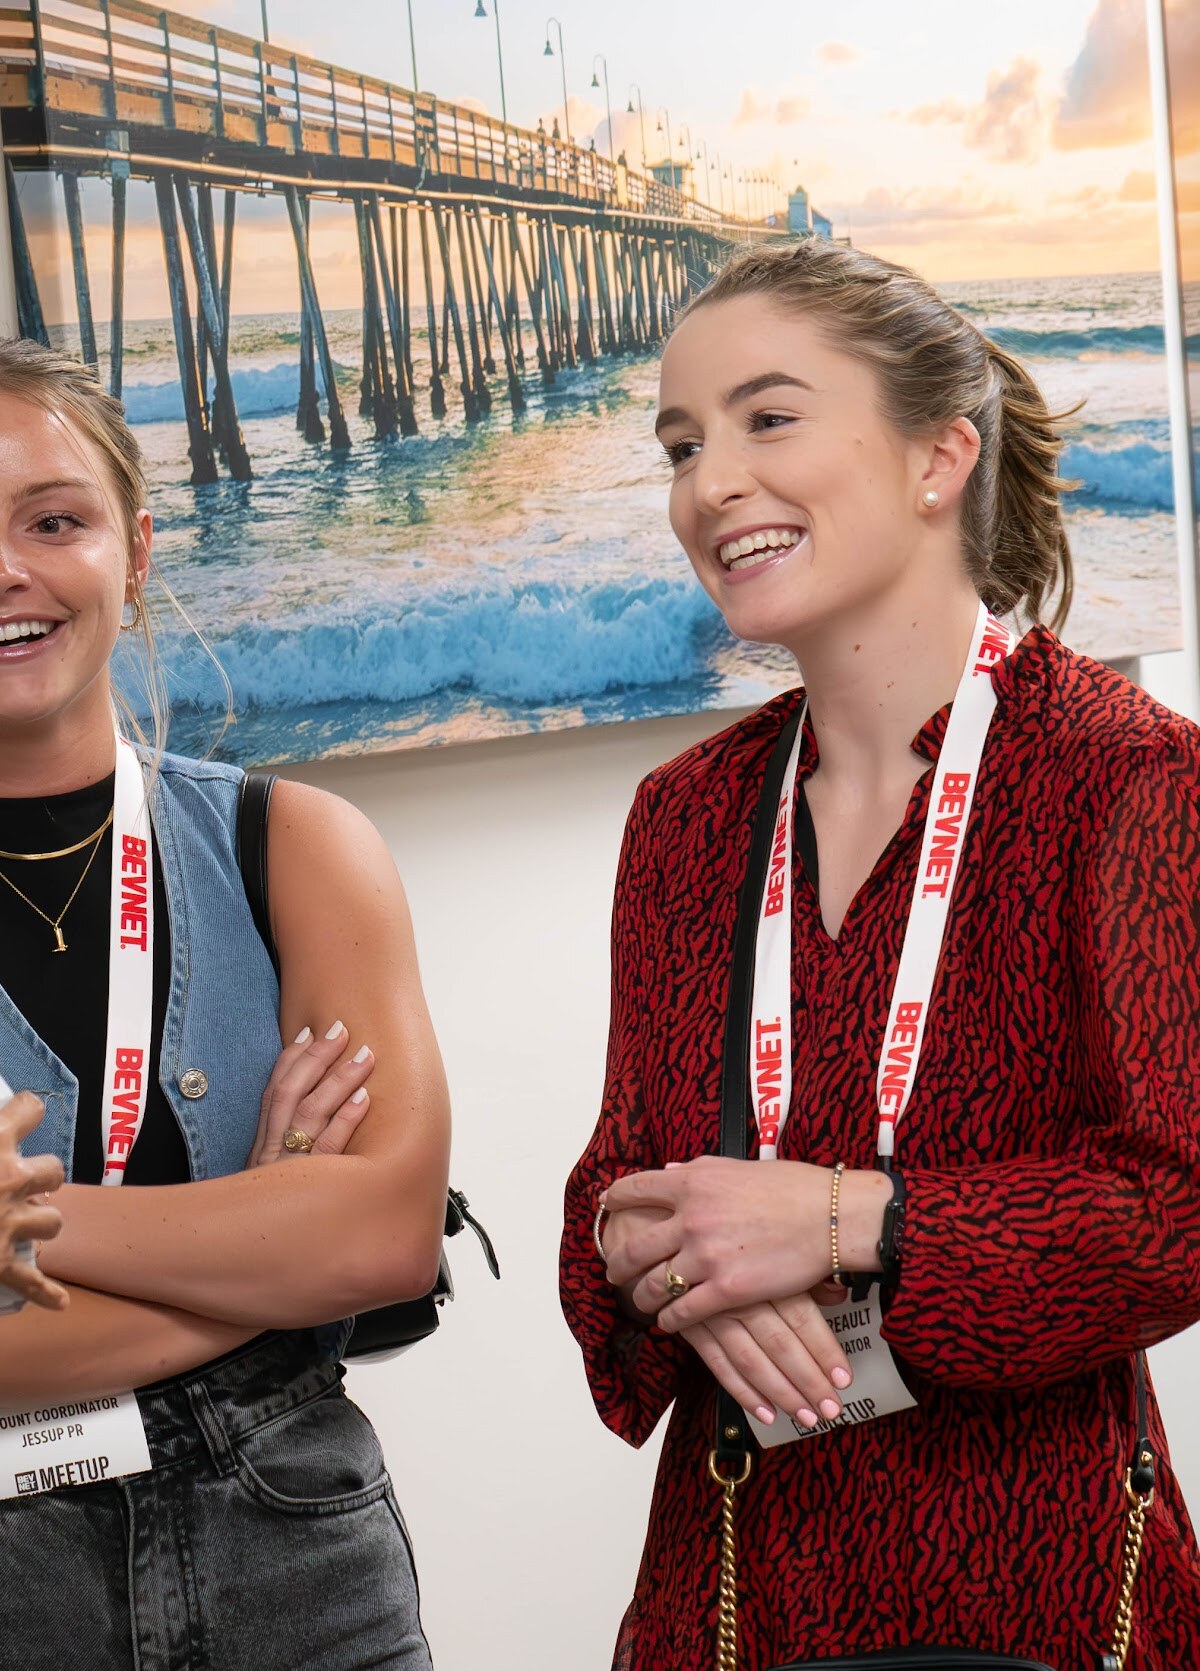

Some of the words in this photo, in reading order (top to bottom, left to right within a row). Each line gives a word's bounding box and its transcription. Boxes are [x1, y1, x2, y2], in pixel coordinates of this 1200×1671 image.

[34, 1397, 120, 1423] COORDINATOR
[22, 1427, 64, 1447] JESSUP
[68, 1423, 84, 1438] PR
[39, 1456, 109, 1490] MEETUP
